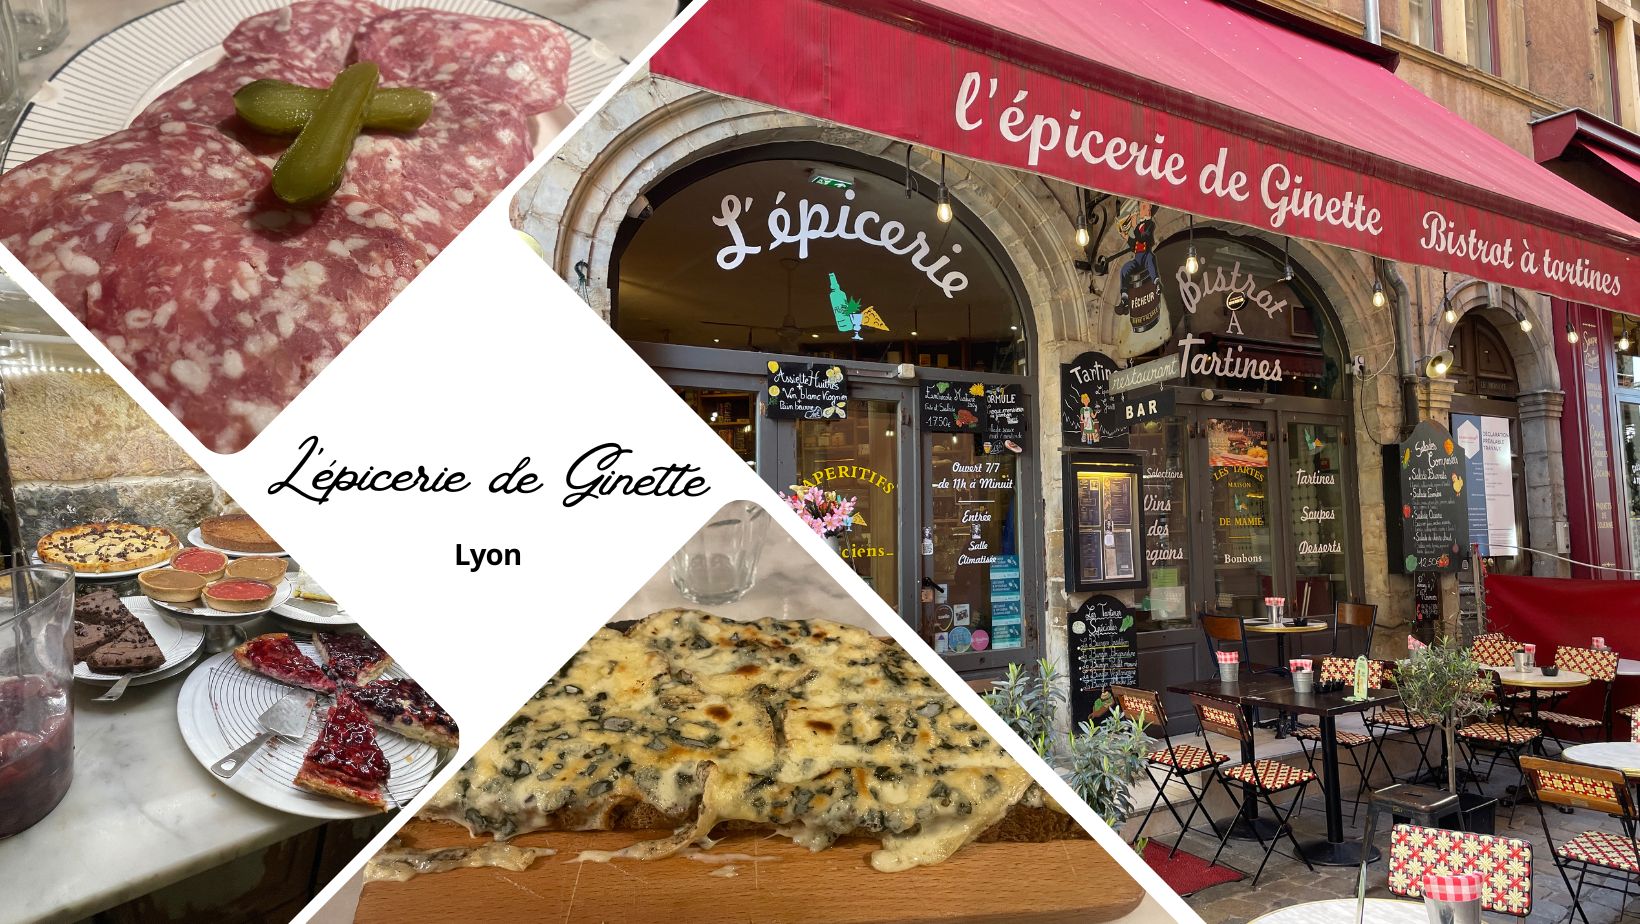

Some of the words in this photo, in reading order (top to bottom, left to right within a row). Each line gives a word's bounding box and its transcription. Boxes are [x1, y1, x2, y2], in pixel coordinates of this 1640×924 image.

[955, 71, 1187, 186] l'épicerie
[1199, 147, 1250, 201] de
[1260, 163, 1383, 236] Ginette
[1420, 210, 1514, 269] Bistrot
[1520, 238, 1539, 275] à
[1543, 248, 1621, 297] tartines
[712, 188, 969, 299] L'épicerie
[1175, 256, 1288, 319] Bistrot
[1226, 310, 1244, 335] A
[1178, 332, 1283, 382] Tartines
[1110, 357, 1178, 391] restaurant
[782, 387, 798, 400] Vin
[800, 388, 821, 401] blanc
[986, 394, 1016, 404] ORMULE
[1125, 399, 1158, 420] BAR
[952, 461, 983, 473] Ouvert
[985, 462, 1001, 474] 7/7
[1213, 466, 1230, 482] LES
[1231, 464, 1265, 482] TARTES
[803, 465, 895, 494] APERITIFS
[937, 478, 950, 489] de
[979, 477, 1014, 489] Minuit
[1296, 468, 1335, 485] Tartines
[1143, 494, 1172, 512] Vins
[961, 509, 992, 523] Entrée
[1219, 517, 1231, 526] DE
[1234, 517, 1264, 526] MAMIE
[1300, 505, 1336, 523] Soupes
[1146, 519, 1170, 536] des
[841, 543, 885, 558] ciens
[968, 540, 989, 551] Salle
[1298, 540, 1342, 554] Desserts
[958, 554, 997, 566] Climatisée
[1224, 553, 1263, 563] Bonbons
